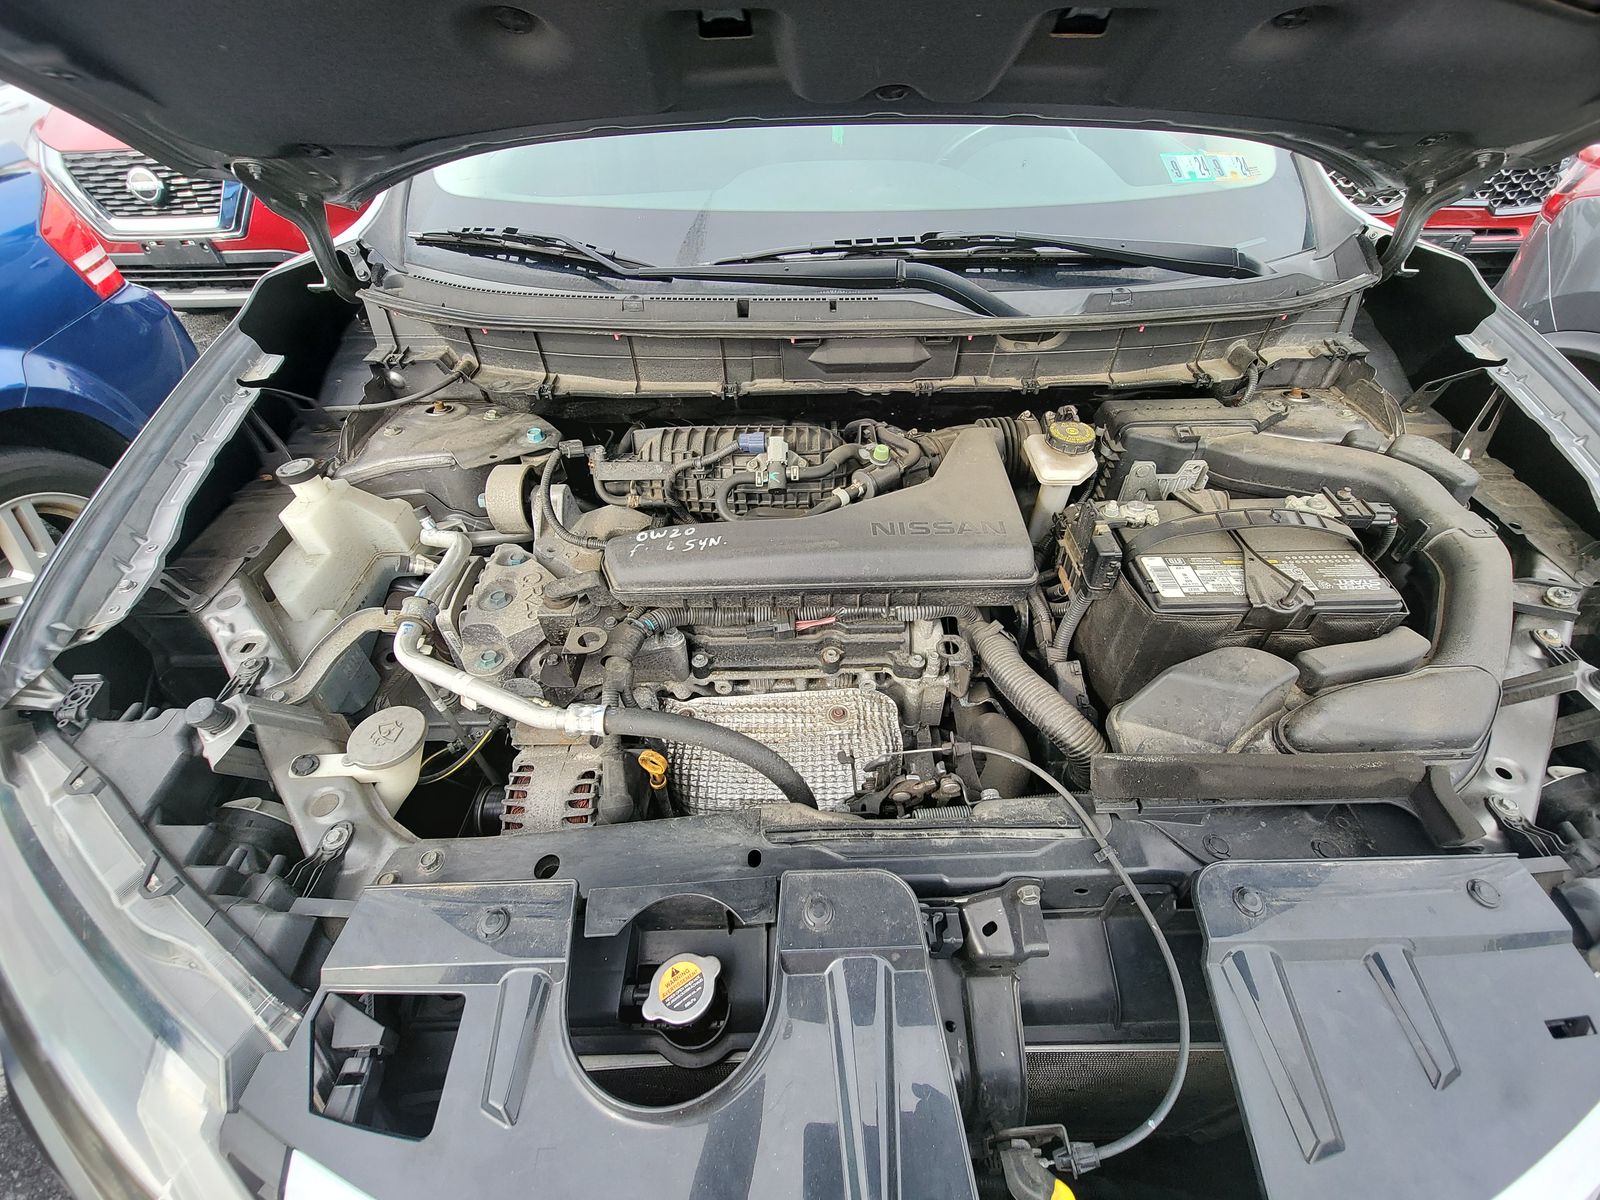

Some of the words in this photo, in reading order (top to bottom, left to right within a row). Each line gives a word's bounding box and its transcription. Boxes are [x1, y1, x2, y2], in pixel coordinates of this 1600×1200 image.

[1193, 155, 1211, 176] 24
[870, 520, 1007, 536] NISSAN
[664, 968, 690, 988] WARNING
